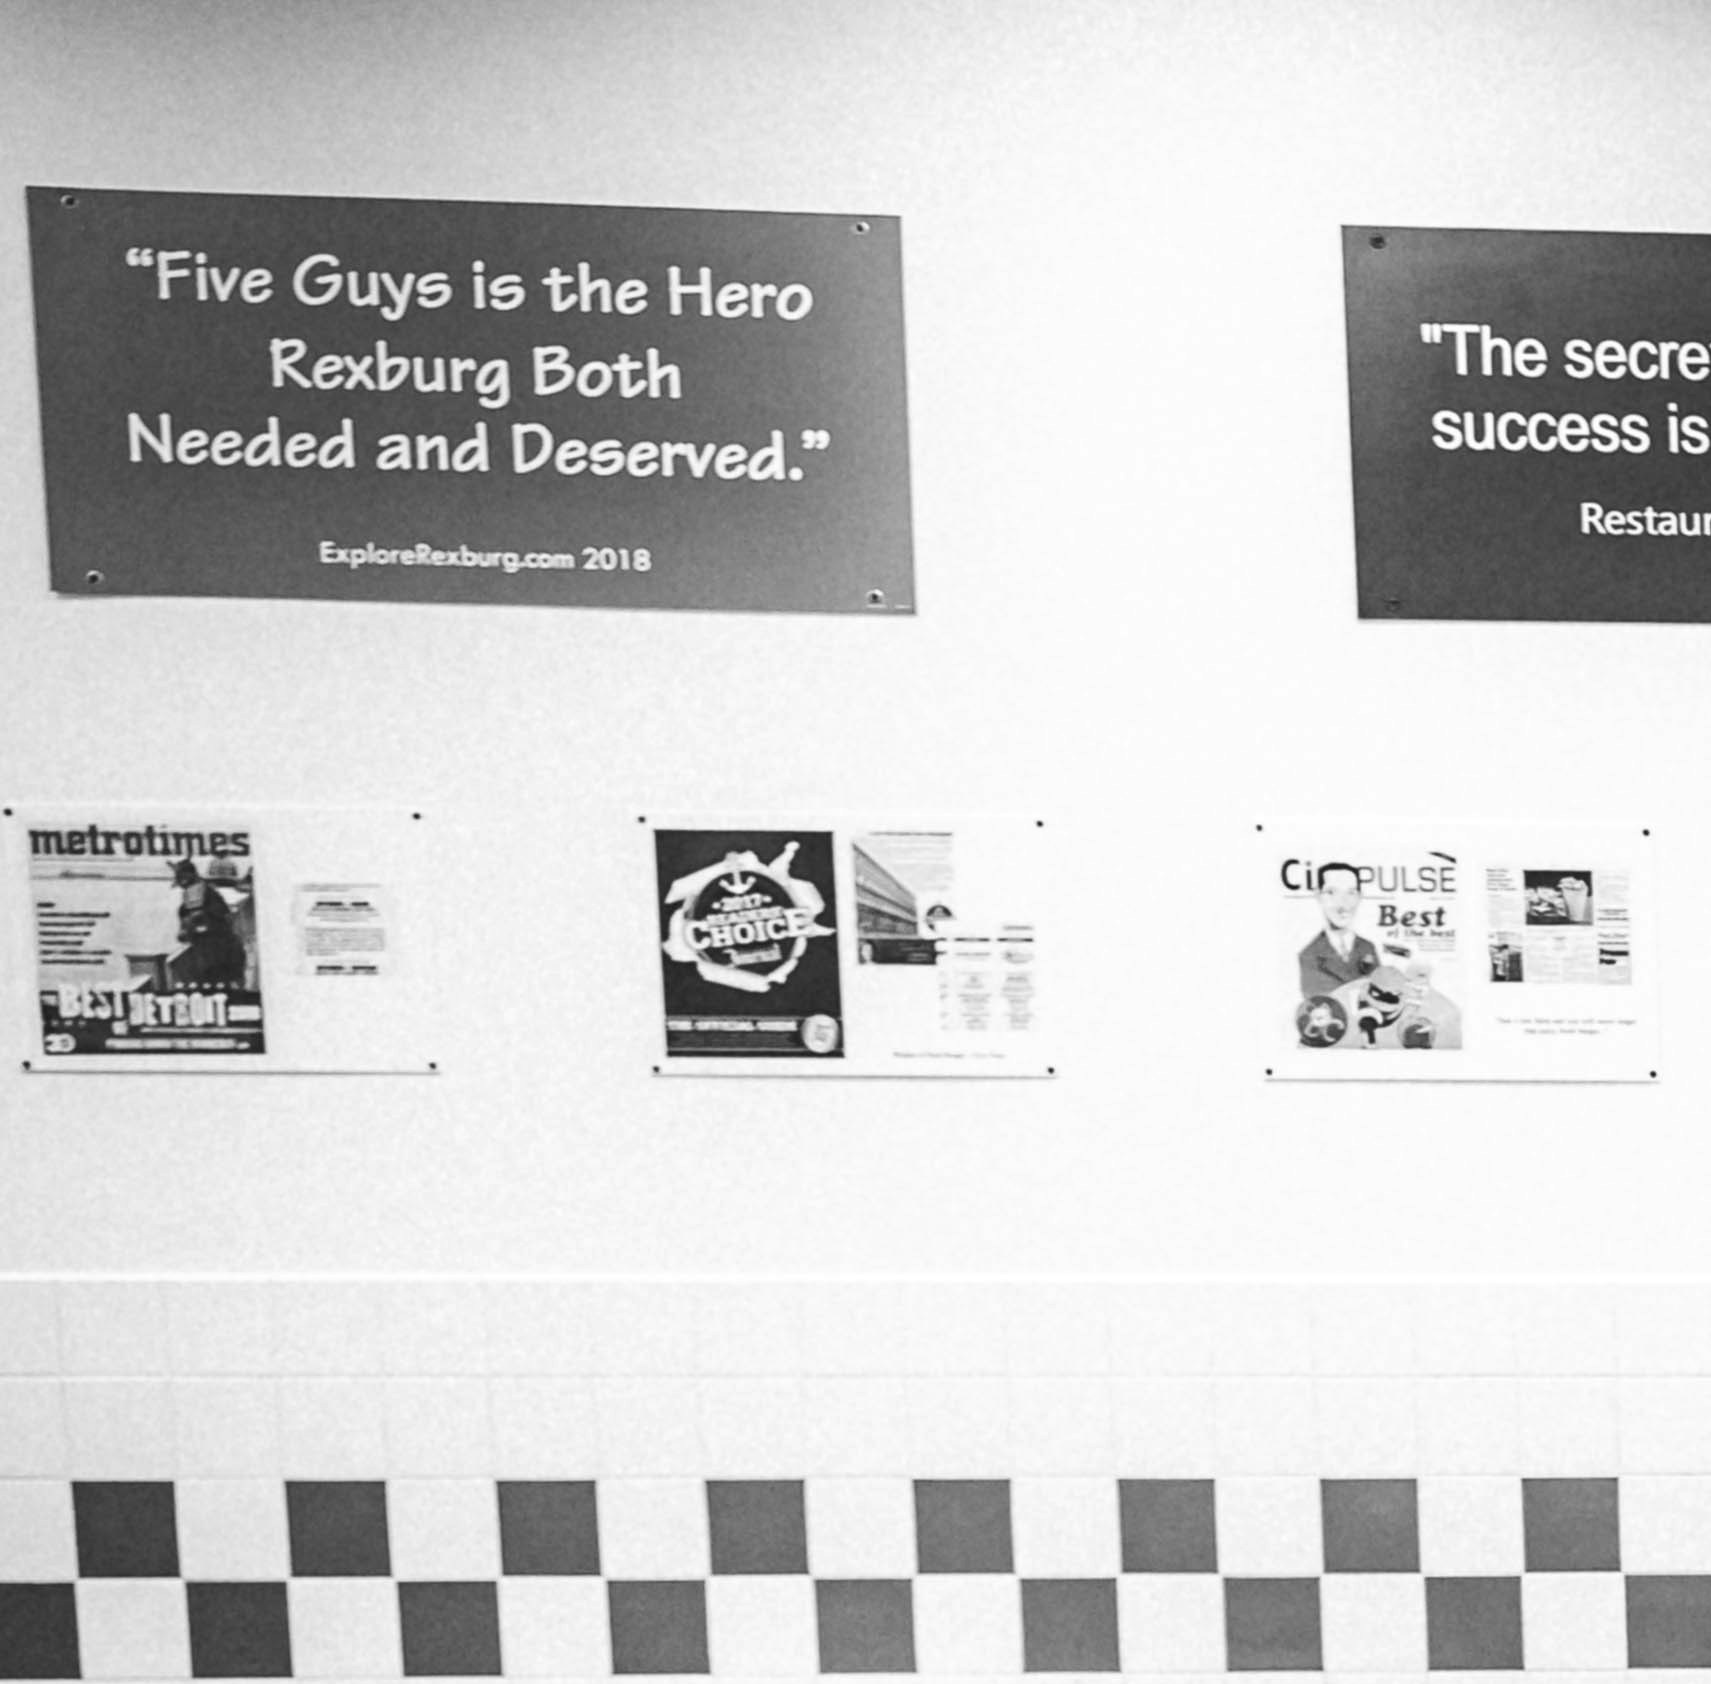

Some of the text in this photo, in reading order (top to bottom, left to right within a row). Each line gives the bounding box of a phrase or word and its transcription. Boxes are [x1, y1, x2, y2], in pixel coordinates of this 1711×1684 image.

[294, 254, 452, 320] Guys
[473, 261, 525, 310] is
[542, 262, 647, 314] the
[669, 266, 813, 320] Hero
[270, 338, 681, 408] Rexburg Both
[1420, 323, 1547, 377] "The
[129, 413, 355, 468] Needed
[377, 422, 489, 472] and
[1433, 411, 1650, 453] success
[1668, 403, 1710, 454] is
[320, 541, 651, 573] ExploreRexburg.com 2018
[29, 825, 250, 856] metrotimes
[1378, 905, 1446, 928] Best
